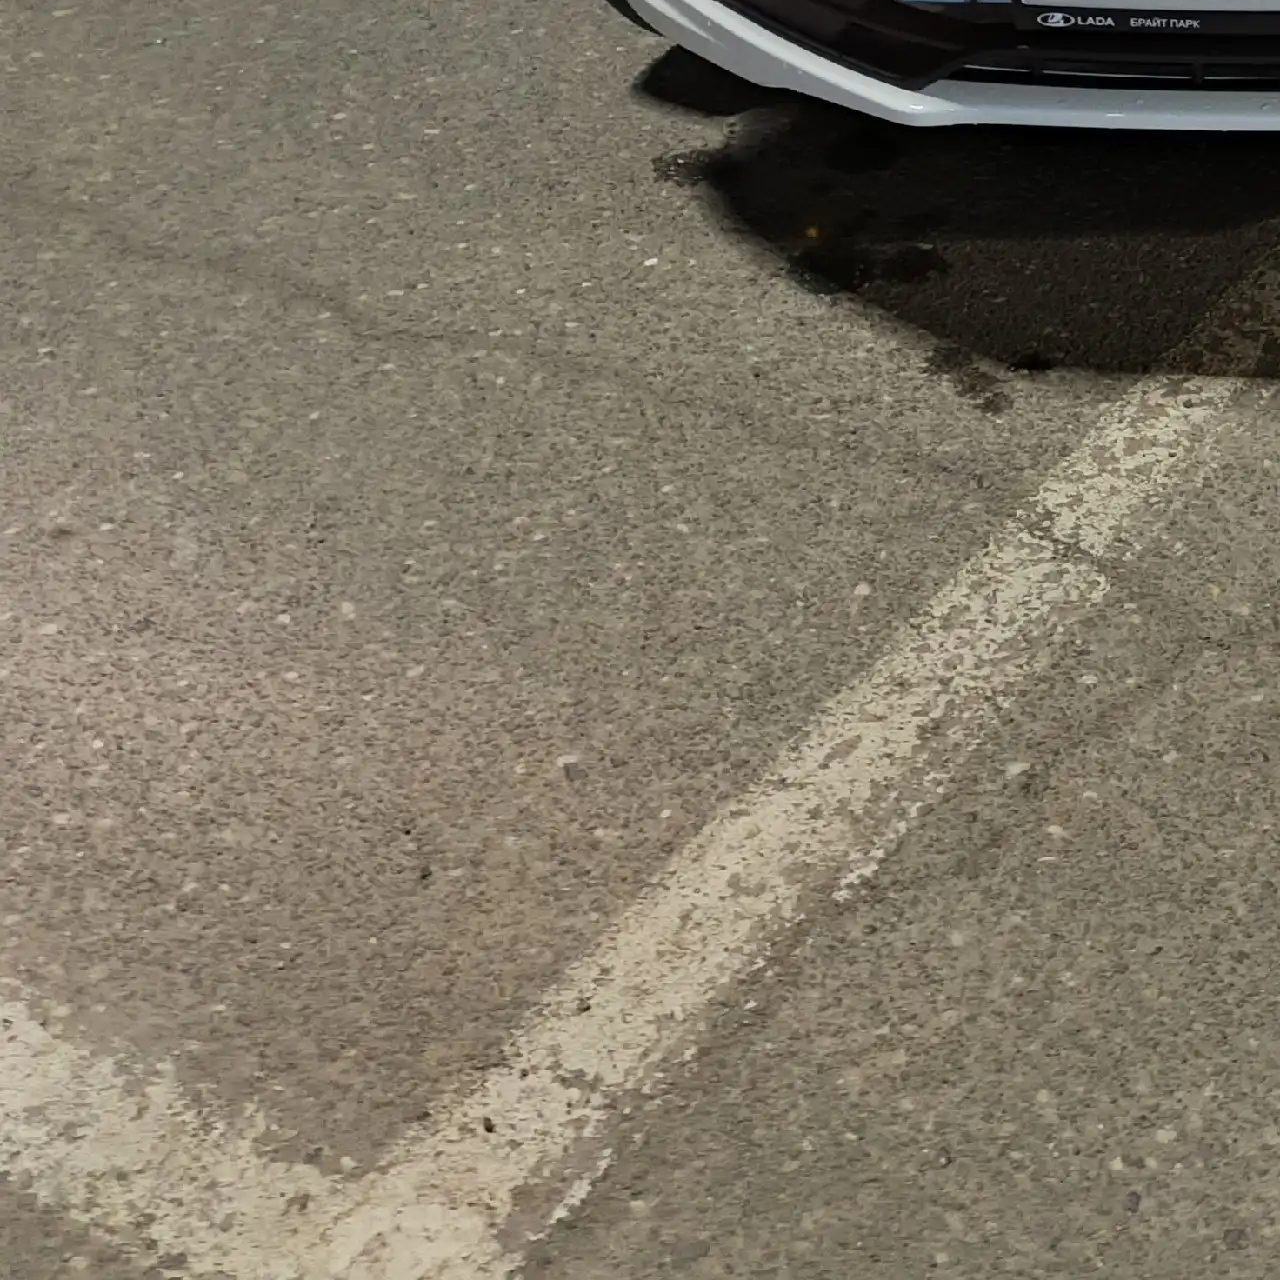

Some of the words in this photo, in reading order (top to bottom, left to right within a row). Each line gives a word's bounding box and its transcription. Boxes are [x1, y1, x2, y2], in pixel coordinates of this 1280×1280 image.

[1077, 16, 1115, 27] LADA
[1130, 16, 1167, 28] БРАЙТ
[1169, 18, 1200, 29] ПАРК
